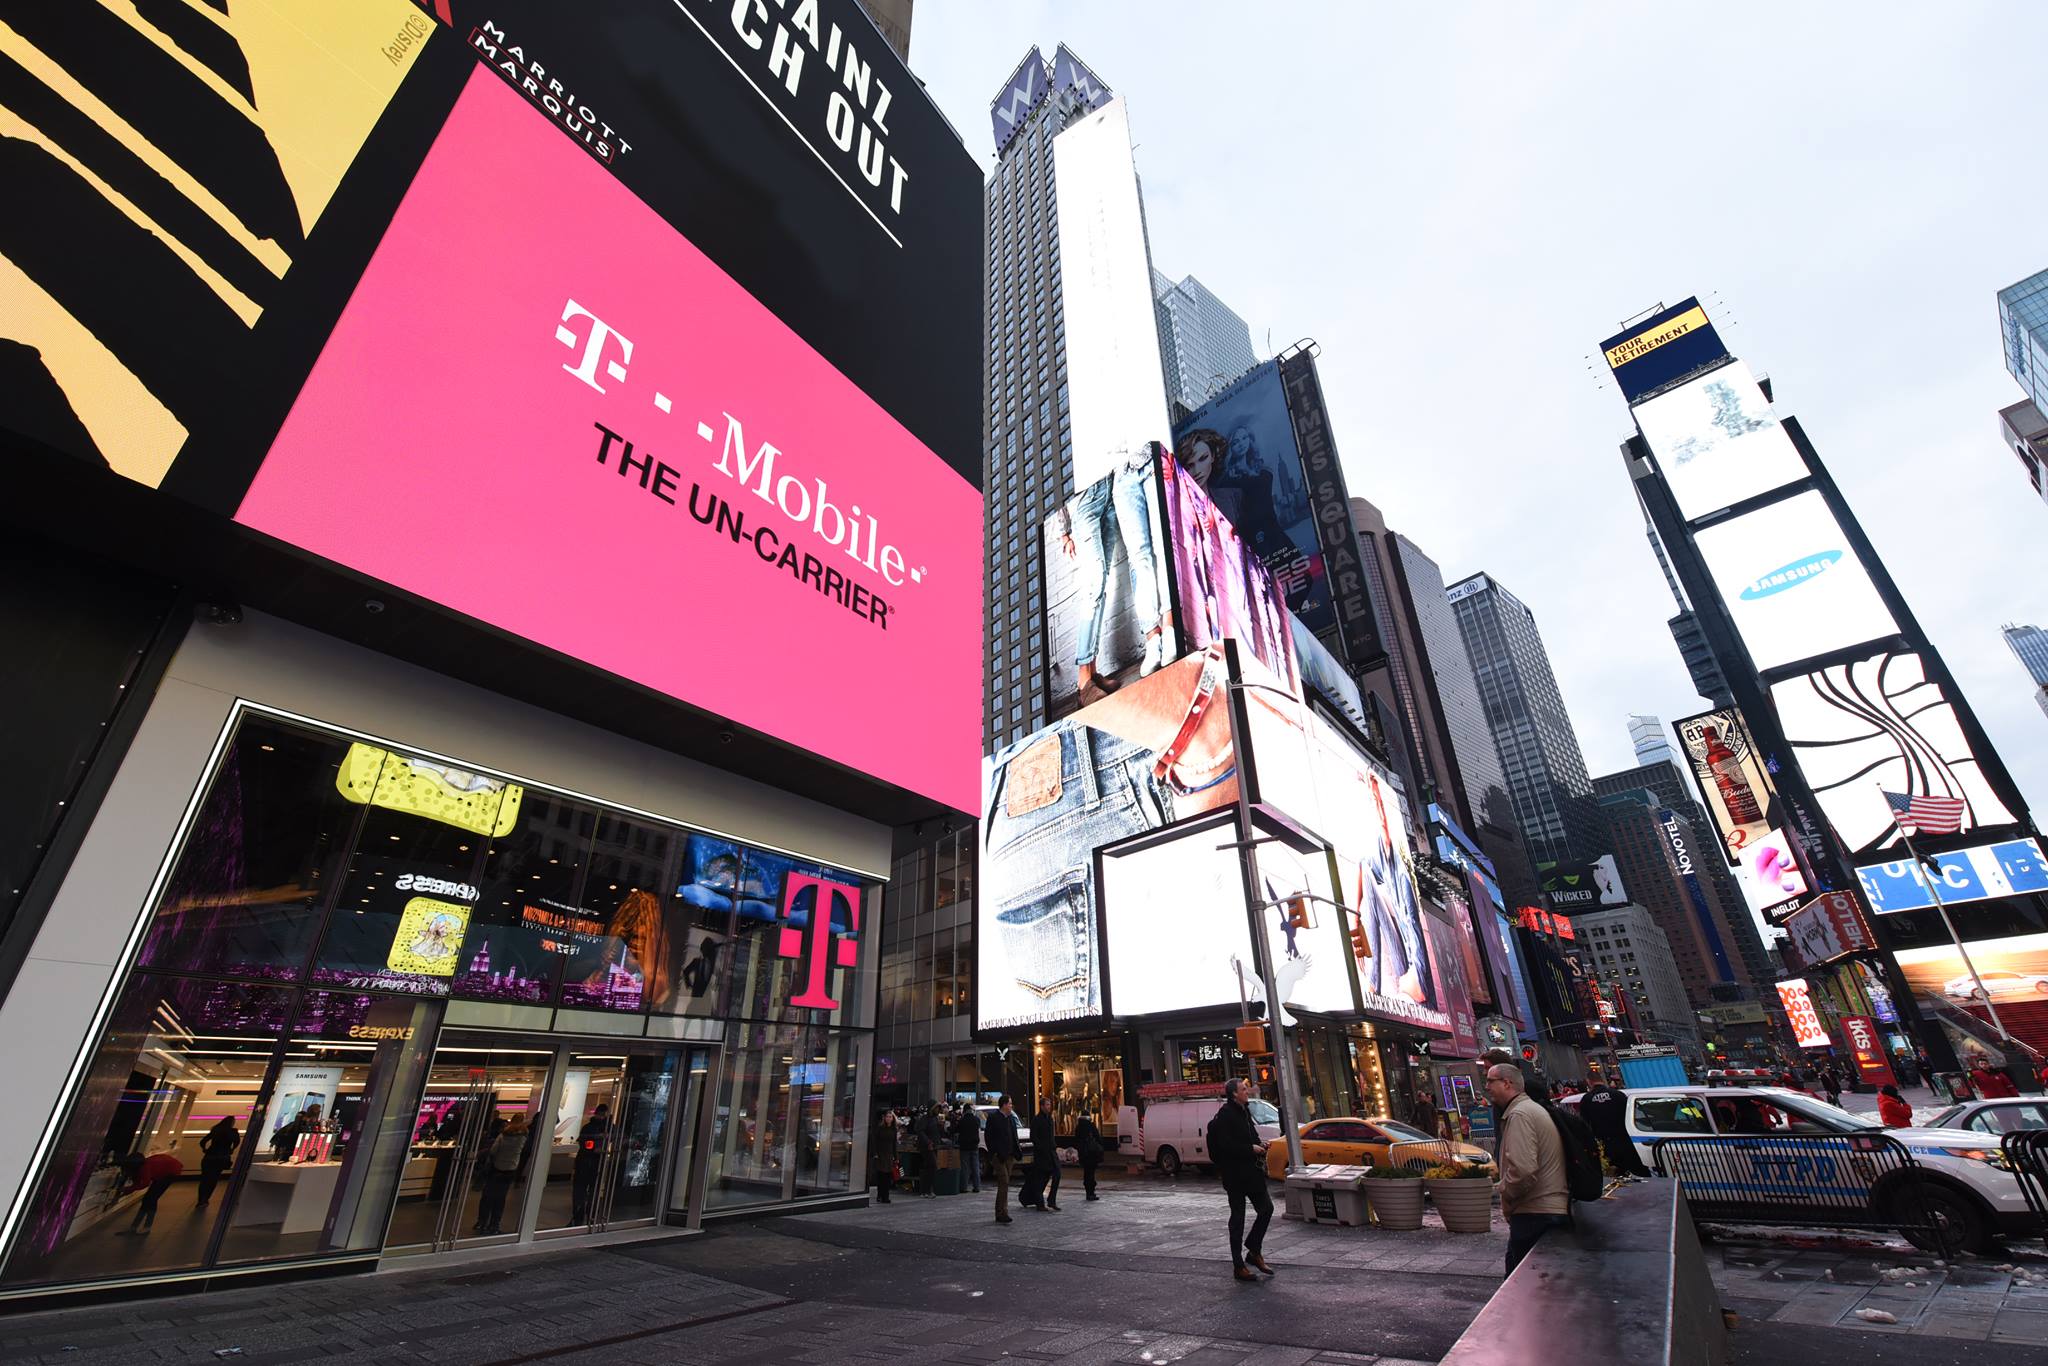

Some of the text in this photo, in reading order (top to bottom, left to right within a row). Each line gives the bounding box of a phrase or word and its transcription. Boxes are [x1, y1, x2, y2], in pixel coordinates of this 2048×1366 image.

[483, 20, 633, 154] MARRIOTT
[774, 0, 893, 136] AINZ
[474, 35, 610, 158] MARQUIS
[731, 0, 909, 215] CH OUT
[1610, 337, 1643, 357] YOUR
[1614, 323, 1689, 365] RETIREMENT
[594, 422, 681, 506] THE
[1290, 373, 1366, 622] TIMES SQUARE
[1447, 589, 1462, 601] nz
[1751, 558, 1836, 593] SAMSUNG
[1663, 816, 1695, 875] NOVOTEL
[1770, 898, 1801, 918] INGLOT
[778, 870, 861, 1010] T
[979, 1016, 1019, 1030] AMERICAN
[1020, 1012, 1045, 1025] EAGLE
[1847, 1018, 1872, 1050] tkts
[1750, 1154, 1839, 1184] NYPD
